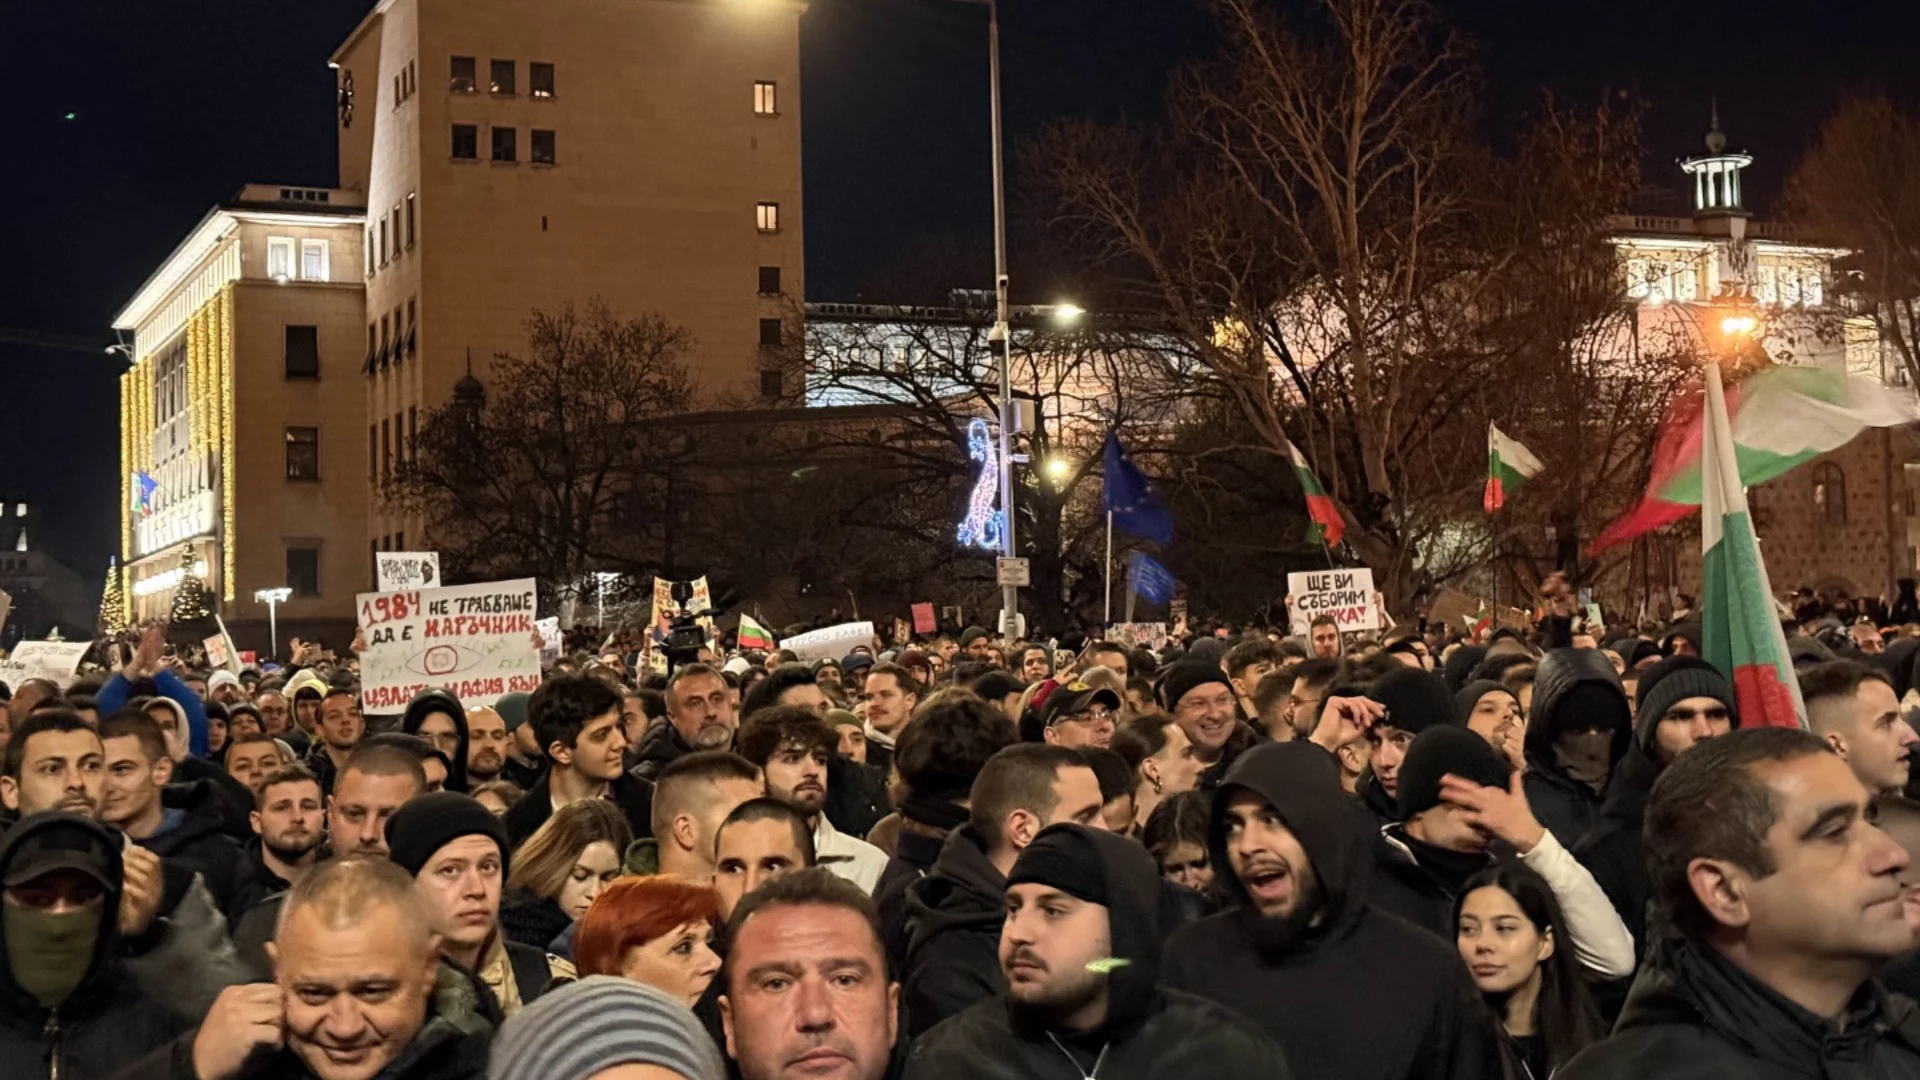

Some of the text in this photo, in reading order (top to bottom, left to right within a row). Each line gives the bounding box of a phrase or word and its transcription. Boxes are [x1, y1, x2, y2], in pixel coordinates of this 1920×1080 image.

[1306, 573, 1354, 593] ЩЕ ВИ
[362, 591, 533, 629] 1984 НЕ ТРЯБВАШЕ
[1297, 590, 1366, 611] СЪБОРИМ
[1306, 606, 1367, 625] РКА!
[371, 627, 396, 646] ДА
[402, 625, 414, 641] Е
[424, 614, 532, 638] НАРЪЧНИК
[363, 683, 430, 708] ЦЯЛАТ
